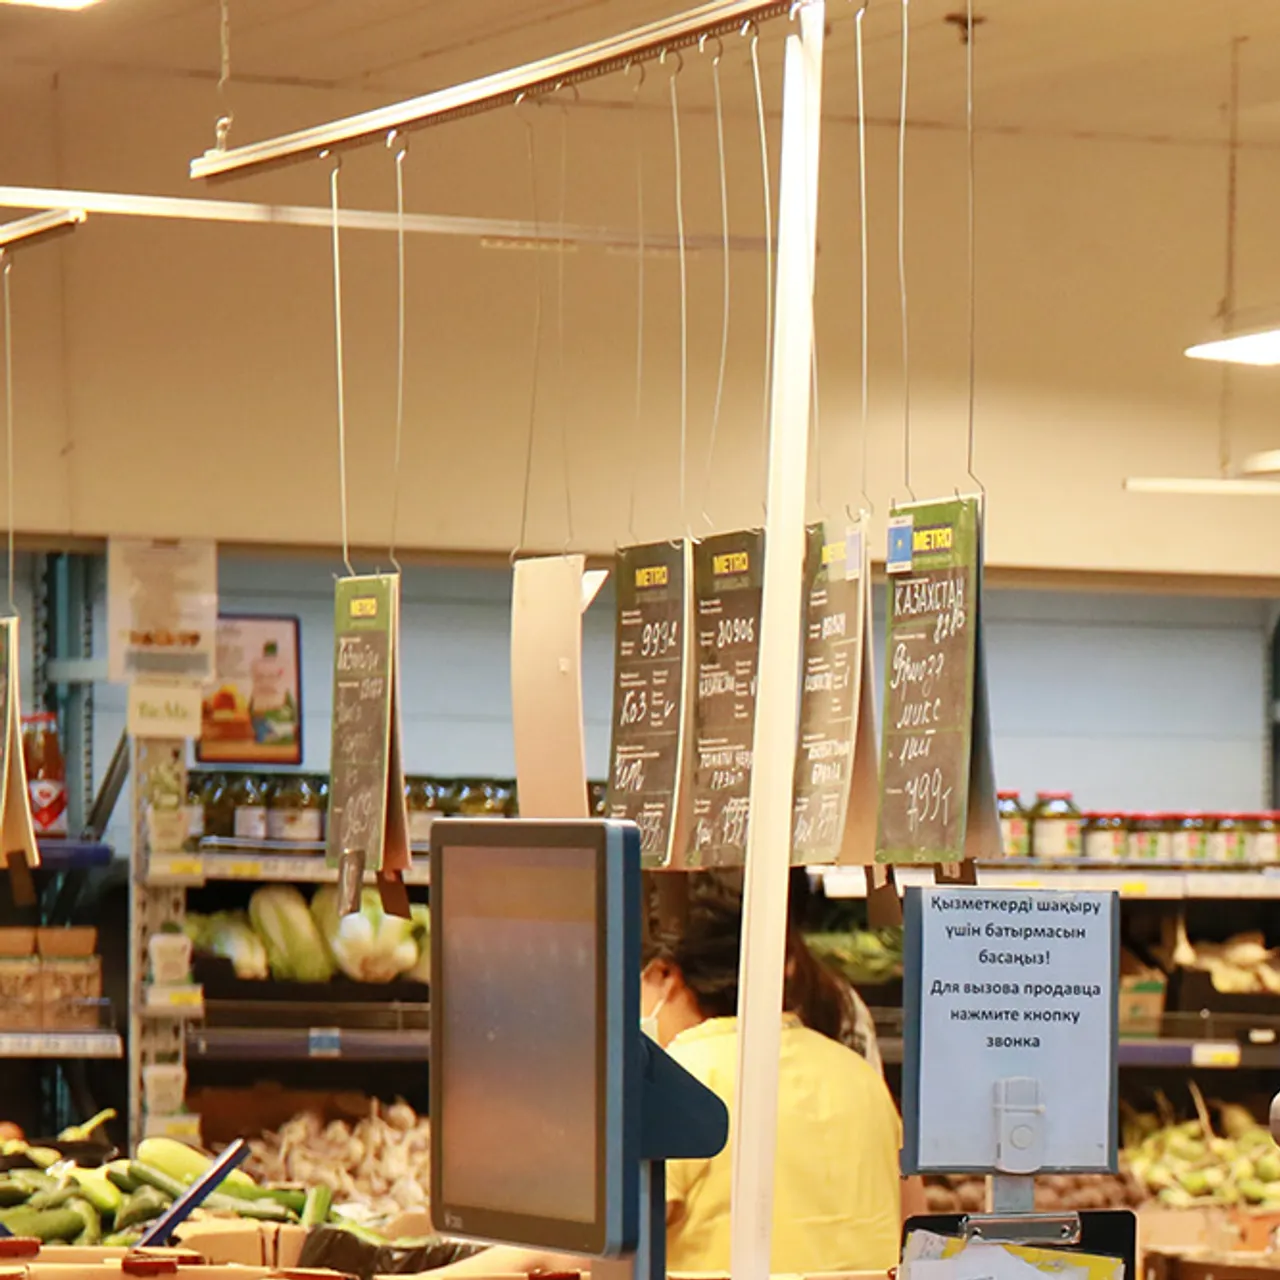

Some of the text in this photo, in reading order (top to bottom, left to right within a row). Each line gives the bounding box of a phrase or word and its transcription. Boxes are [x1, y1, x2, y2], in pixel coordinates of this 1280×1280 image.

[913, 527, 952, 551] METRO
[713, 553, 748, 574] METRO
[635, 566, 668, 587] METRO
[895, 577, 964, 616] КАЗАХСТАН
[931, 896, 1101, 915] Қызметкерді шақыру
[945, 922, 1086, 940] үшін батырмасын
[978, 949, 1050, 966] басаңыз!
[930, 980, 1101, 998] Для вызова продавца
[951, 1009, 1080, 1024] нажмите кнопку
[986, 1036, 1040, 1048] звонка
